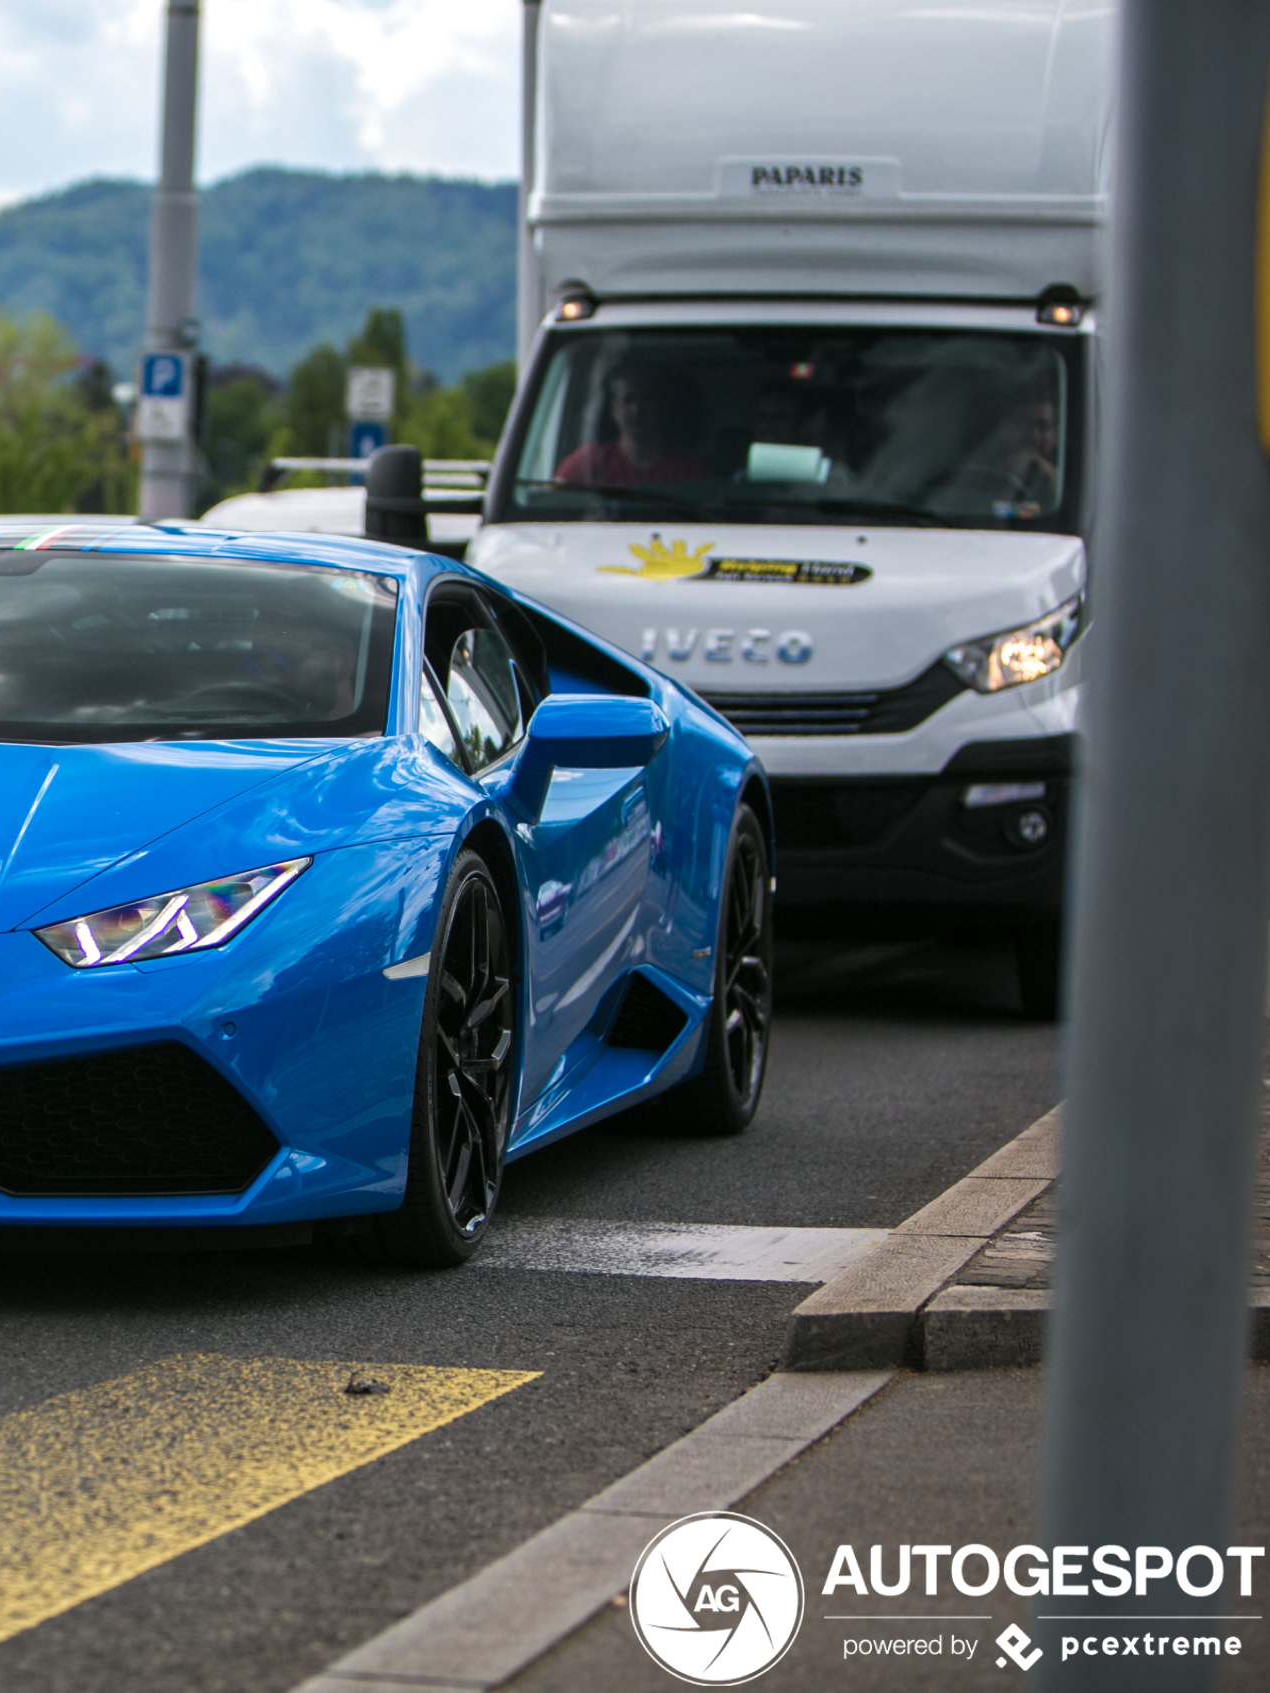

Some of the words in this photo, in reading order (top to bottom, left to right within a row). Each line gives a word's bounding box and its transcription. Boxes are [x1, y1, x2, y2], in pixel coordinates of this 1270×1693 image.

[751, 166, 864, 187] PAPARIS
[151, 359, 176, 393] P
[642, 627, 813, 664] IVECO
